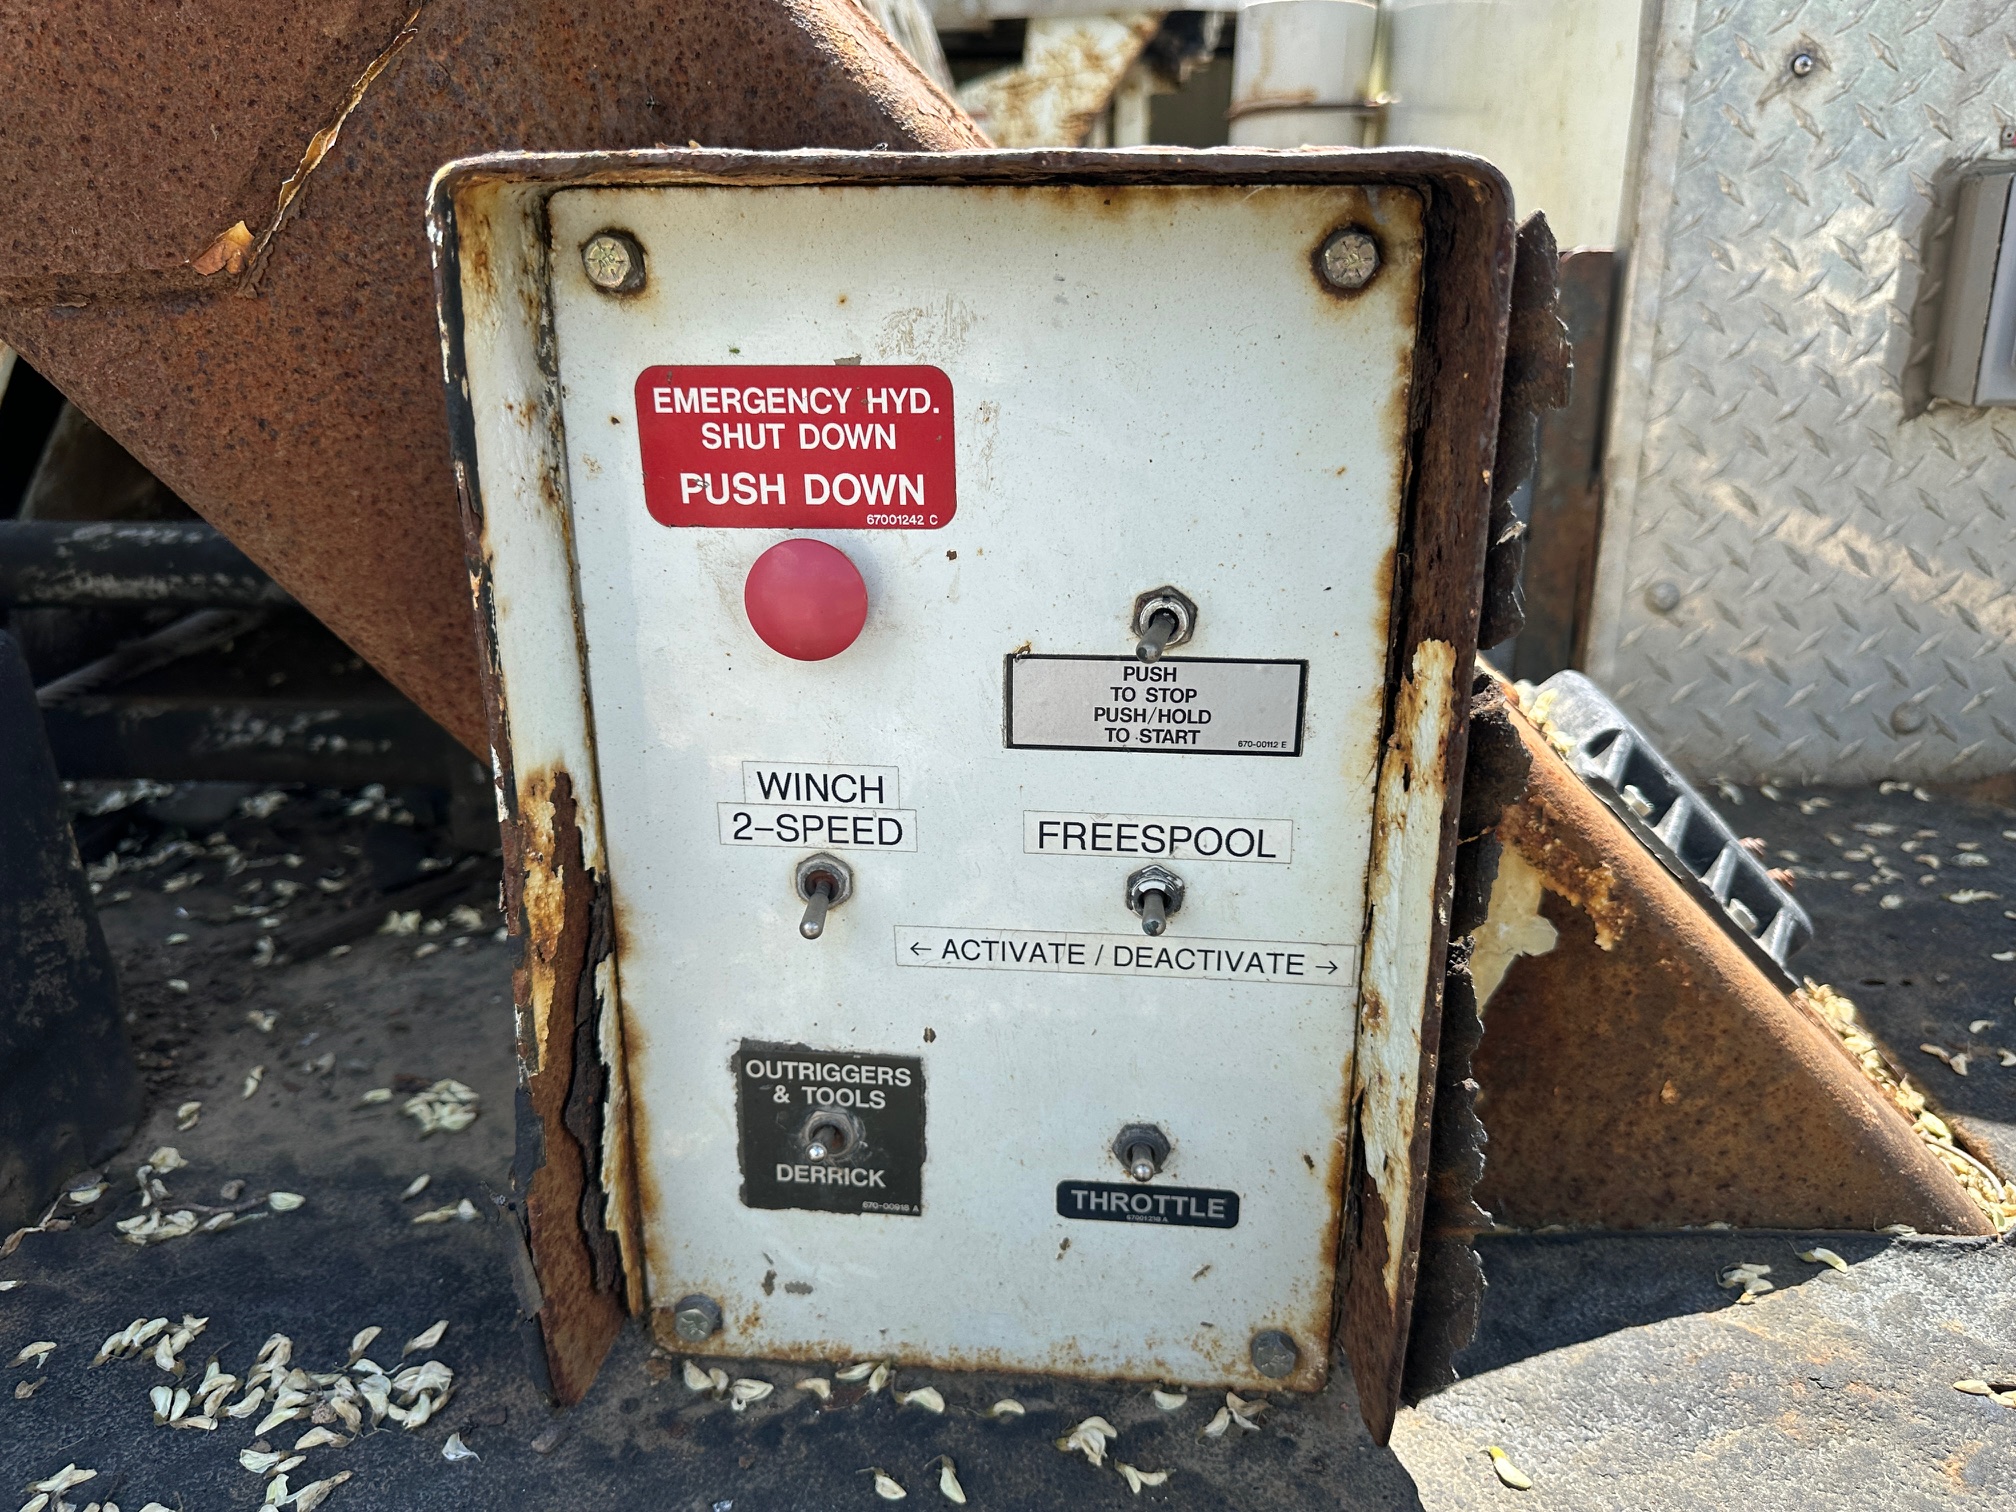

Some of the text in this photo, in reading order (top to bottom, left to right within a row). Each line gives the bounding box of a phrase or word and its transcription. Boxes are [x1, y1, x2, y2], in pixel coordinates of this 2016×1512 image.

[652, 387, 940, 414] EMERGENCY HYD.
[701, 422, 896, 450] SHUT DOWN
[680, 472, 925, 506] PUSH DOWN
[866, 514, 938, 526] 67001242 C
[1123, 666, 1177, 682] PUSH
[1110, 686, 1197, 703] TO STOP
[1094, 706, 1211, 725] PUSH/HOLD
[1104, 727, 1200, 744] TO START
[1237, 740, 1287, 749] 670-00112 E
[756, 771, 885, 805] WINCH
[732, 812, 904, 847] 2-SPEED
[1037, 821, 1277, 859] FREESPOOL
[941, 939, 1305, 976] ACTIVATE / DEACTIVATE
[745, 1059, 912, 1087] OUTRIGGERS
[772, 1084, 886, 1110] & TOOLS
[776, 1164, 886, 1188] DERRICK
[912, 1204, 920, 1213] A
[1071, 1190, 1225, 1217] THROTTLE
